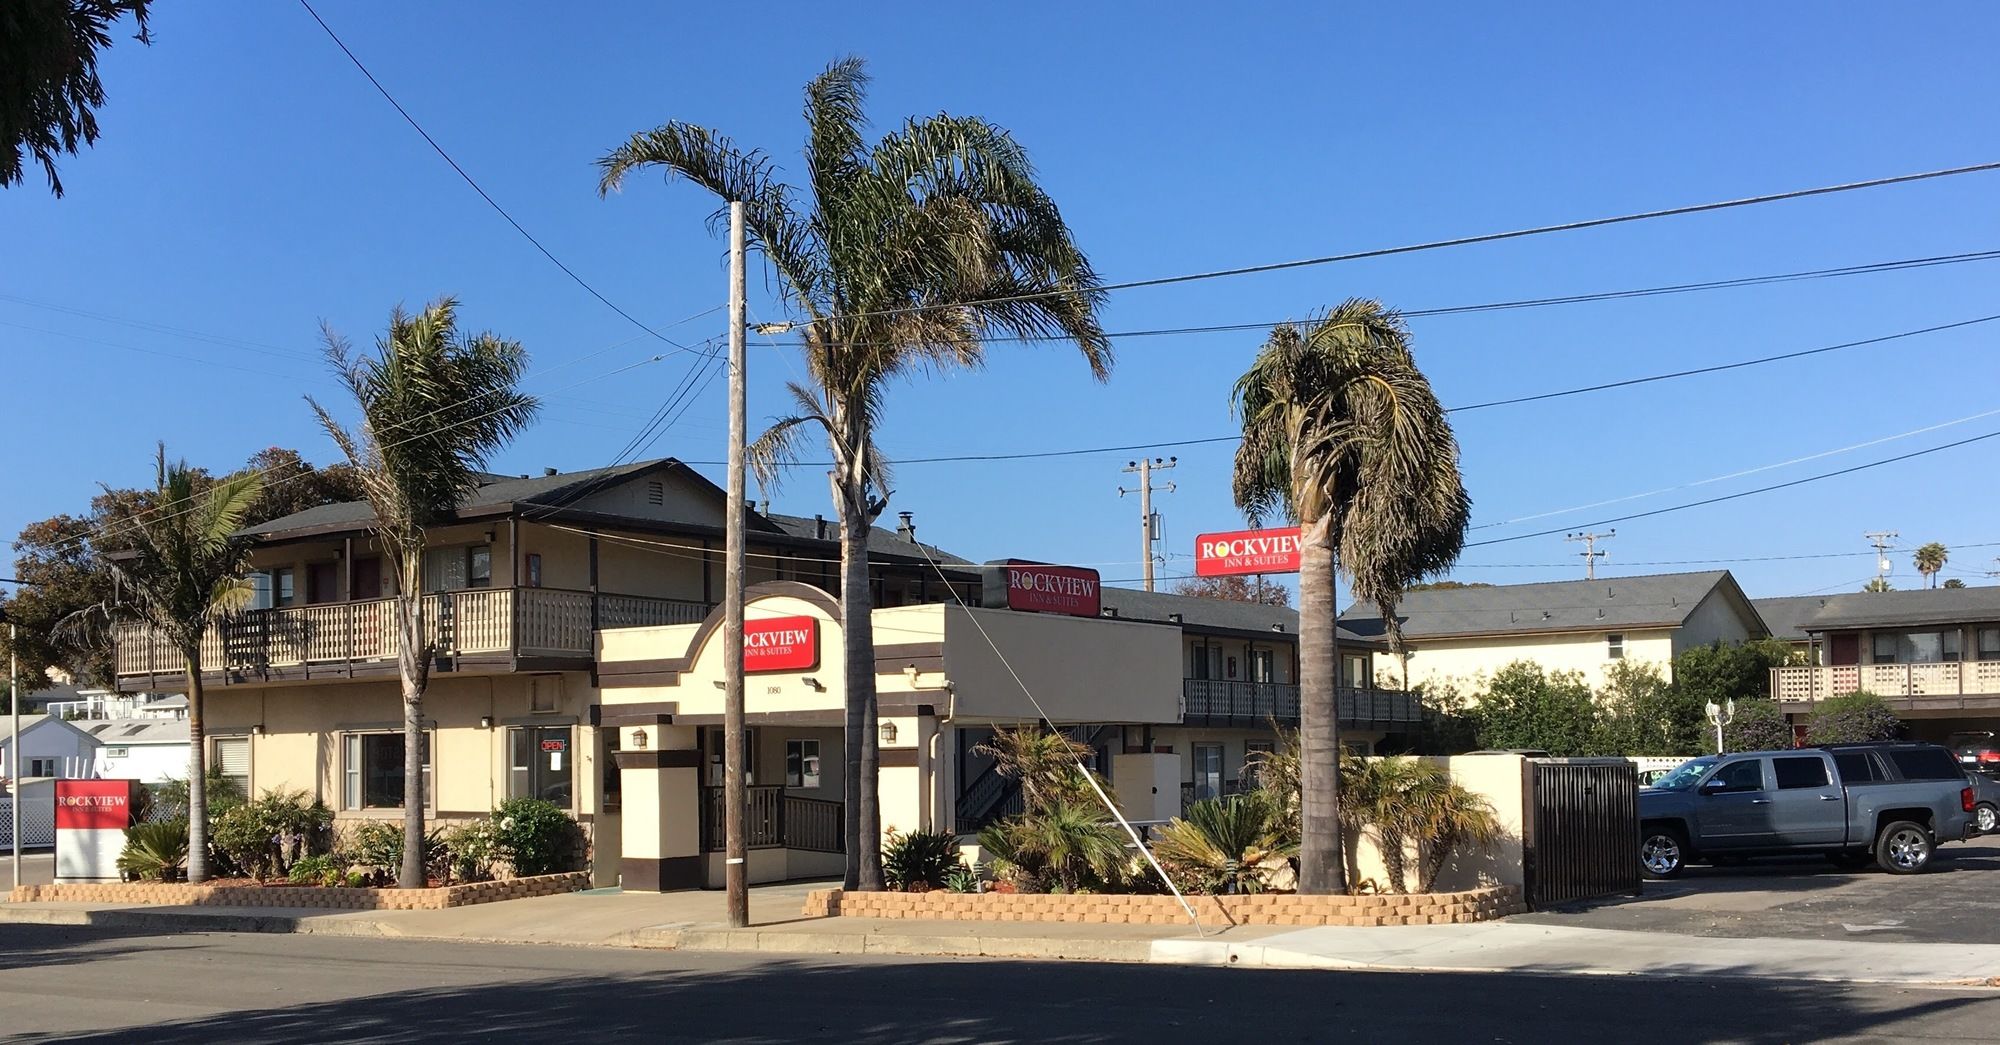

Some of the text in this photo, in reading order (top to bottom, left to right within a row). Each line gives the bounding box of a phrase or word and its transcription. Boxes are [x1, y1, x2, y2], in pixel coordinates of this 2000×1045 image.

[1225, 554, 1289, 567] INN & SUITES
[1010, 570, 1095, 597] ROCKVIEW
[1030, 593, 1044, 603] INN
[1053, 596, 1079, 607] SUITES
[745, 647, 791, 656] INN & SUITES
[767, 686, 781, 694] 1080
[542, 741, 562, 750] OPEN
[59, 796, 126, 806] ROCKVIEW
